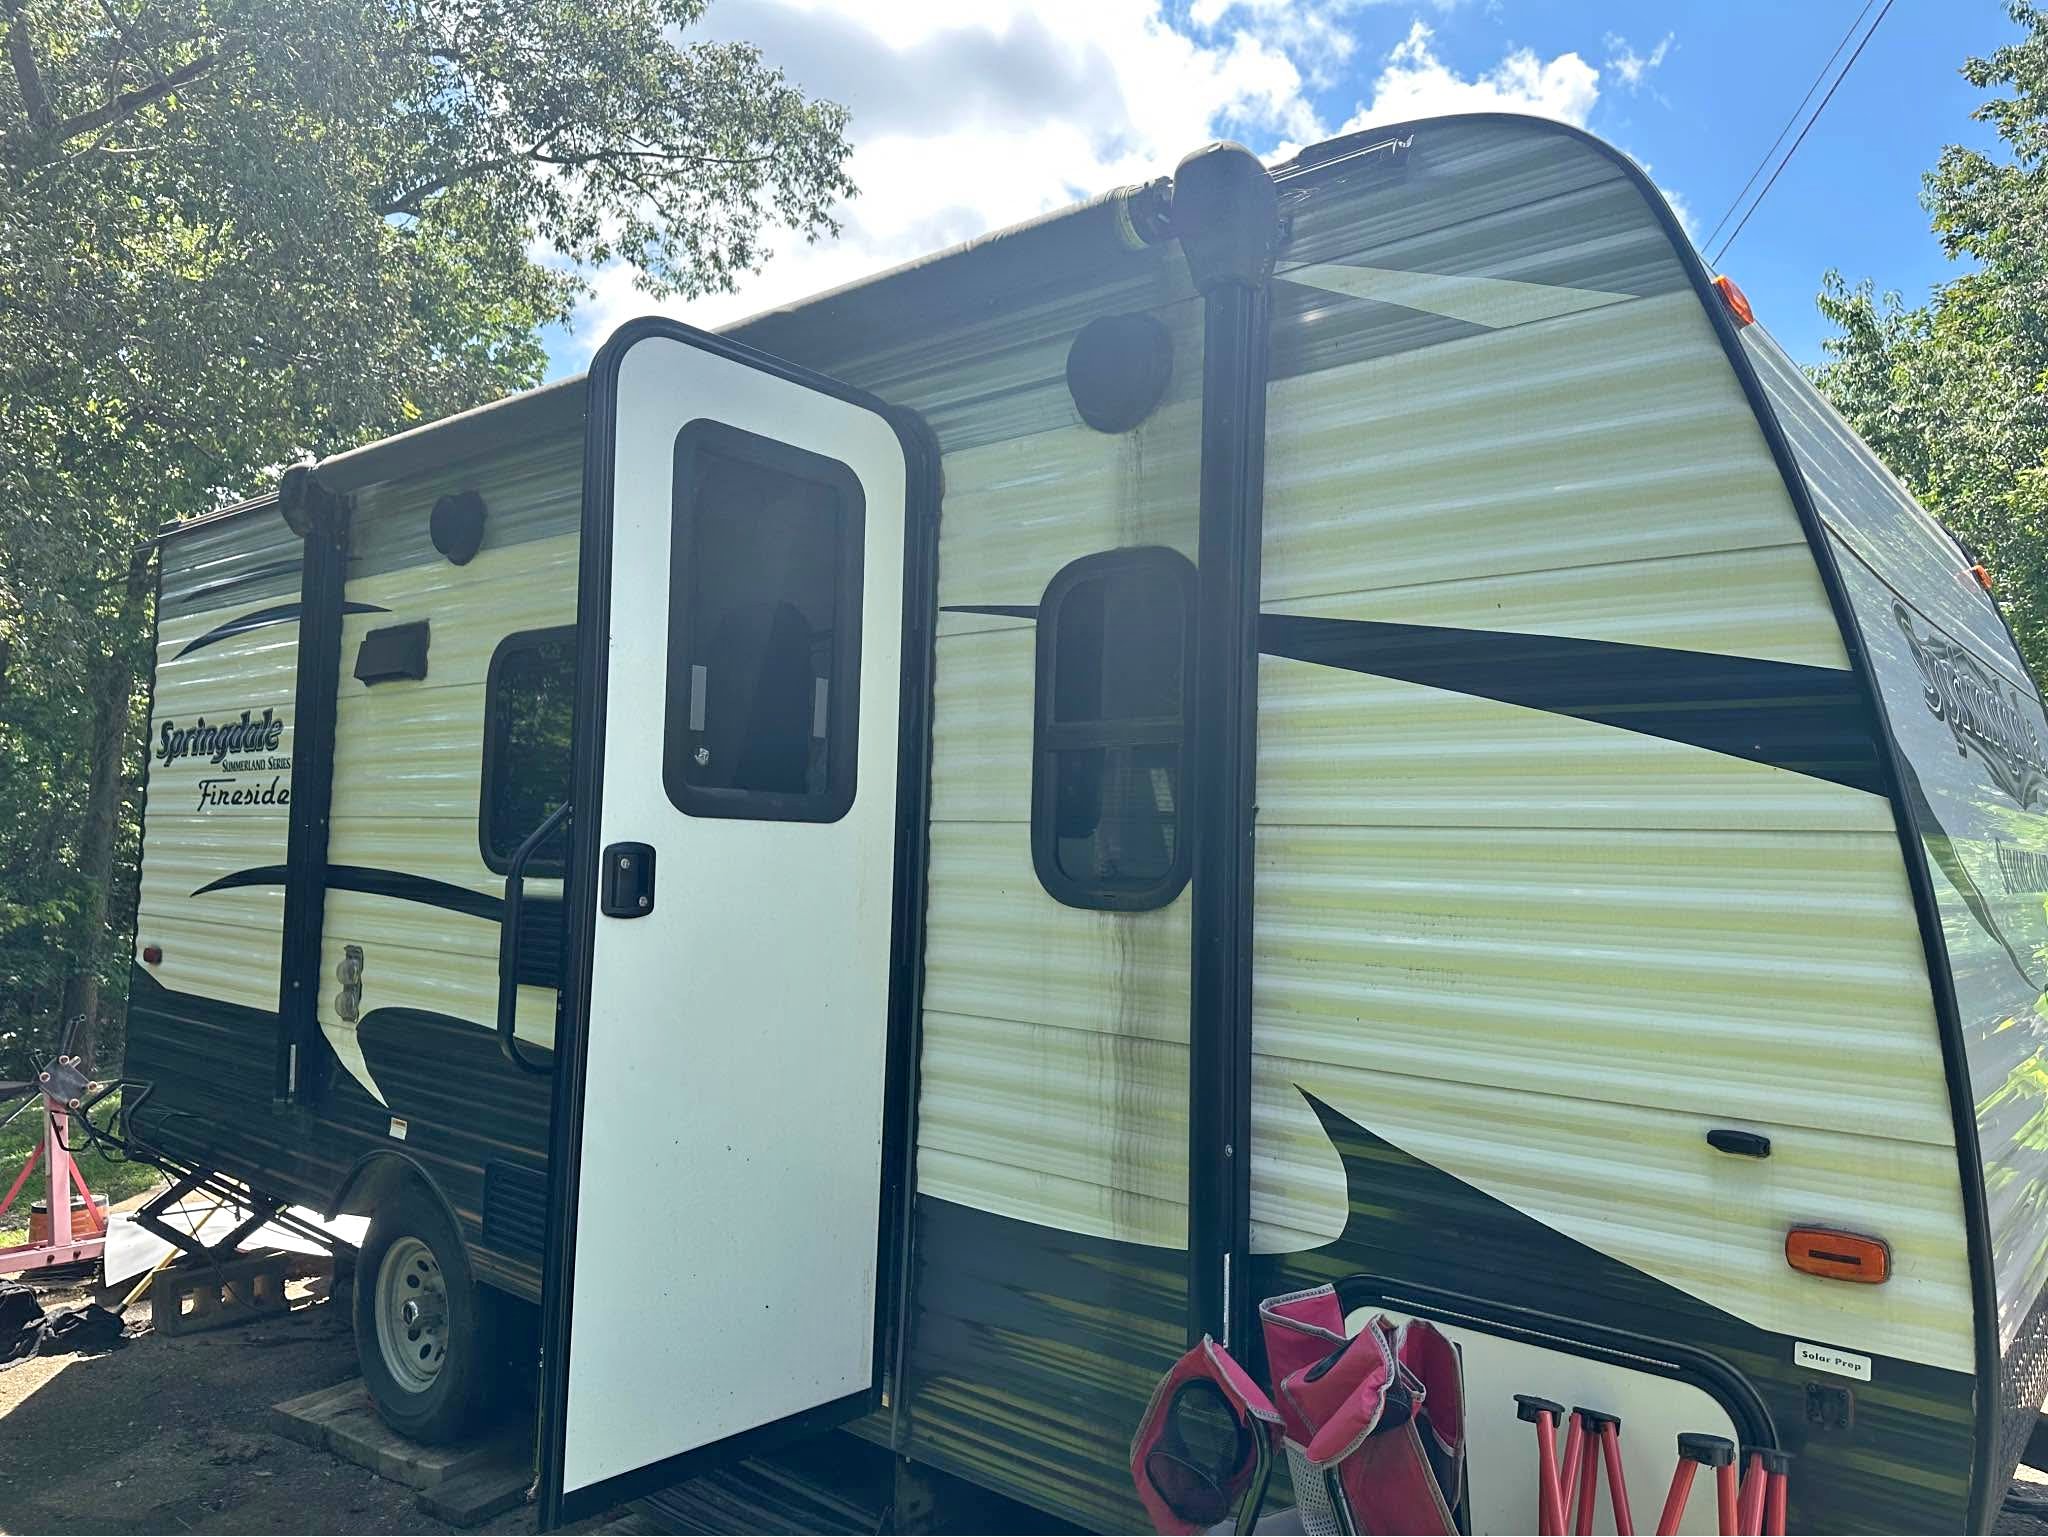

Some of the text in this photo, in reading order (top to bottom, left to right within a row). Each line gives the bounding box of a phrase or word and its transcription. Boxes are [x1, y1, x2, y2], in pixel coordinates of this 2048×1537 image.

[156, 708, 283, 767] Springdale
[222, 756, 291, 772] SUMMERLAND SERIES
[197, 776, 290, 811] Fireside
[1802, 1350, 1861, 1371] Solar Prep
